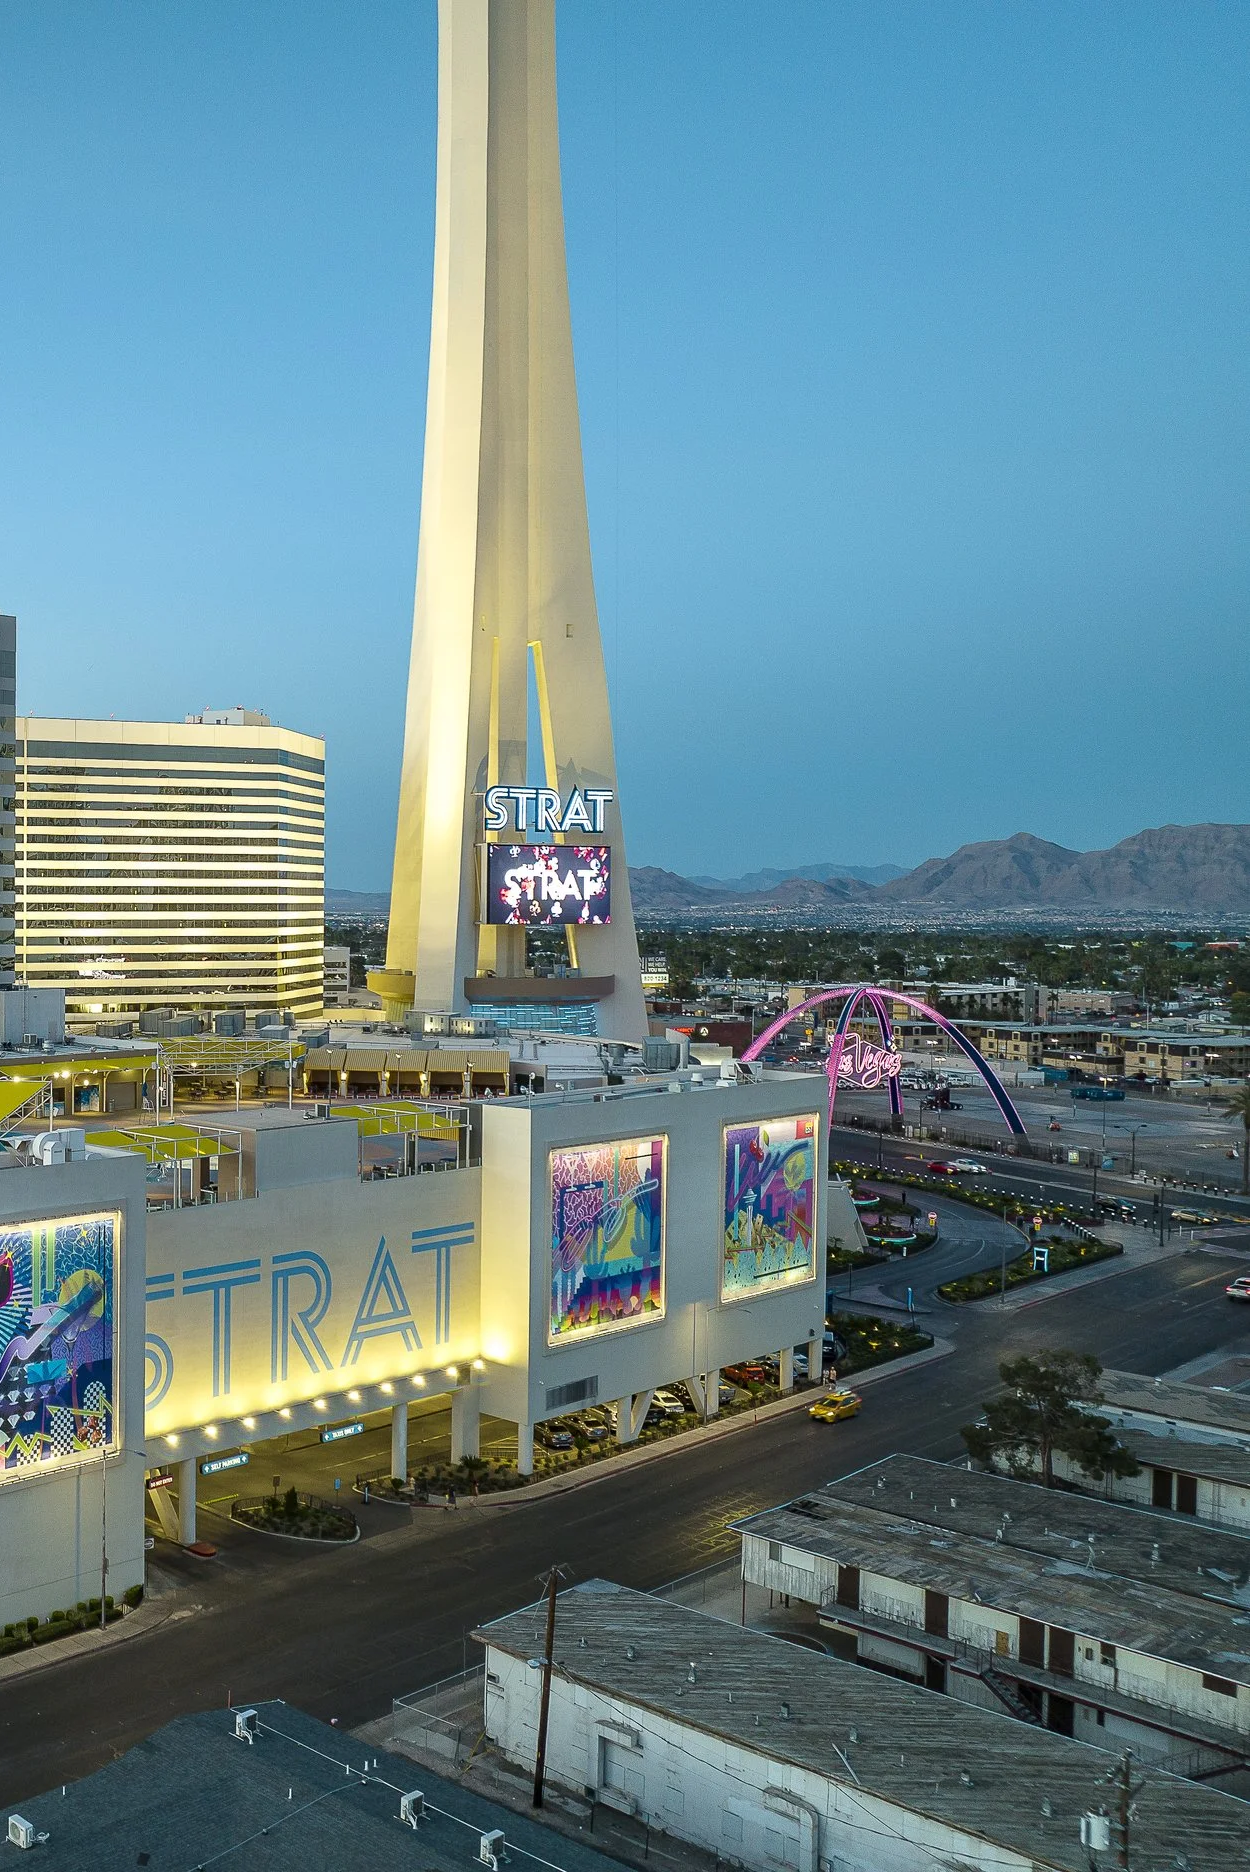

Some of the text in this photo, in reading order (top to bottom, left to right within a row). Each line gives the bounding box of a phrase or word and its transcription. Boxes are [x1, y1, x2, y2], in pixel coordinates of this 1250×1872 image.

[485, 784, 614, 833] STRAT
[504, 868, 596, 902] STRAT
[845, 1033, 903, 1088] Vegas
[210, 1457, 240, 1471] SELF PARKING
